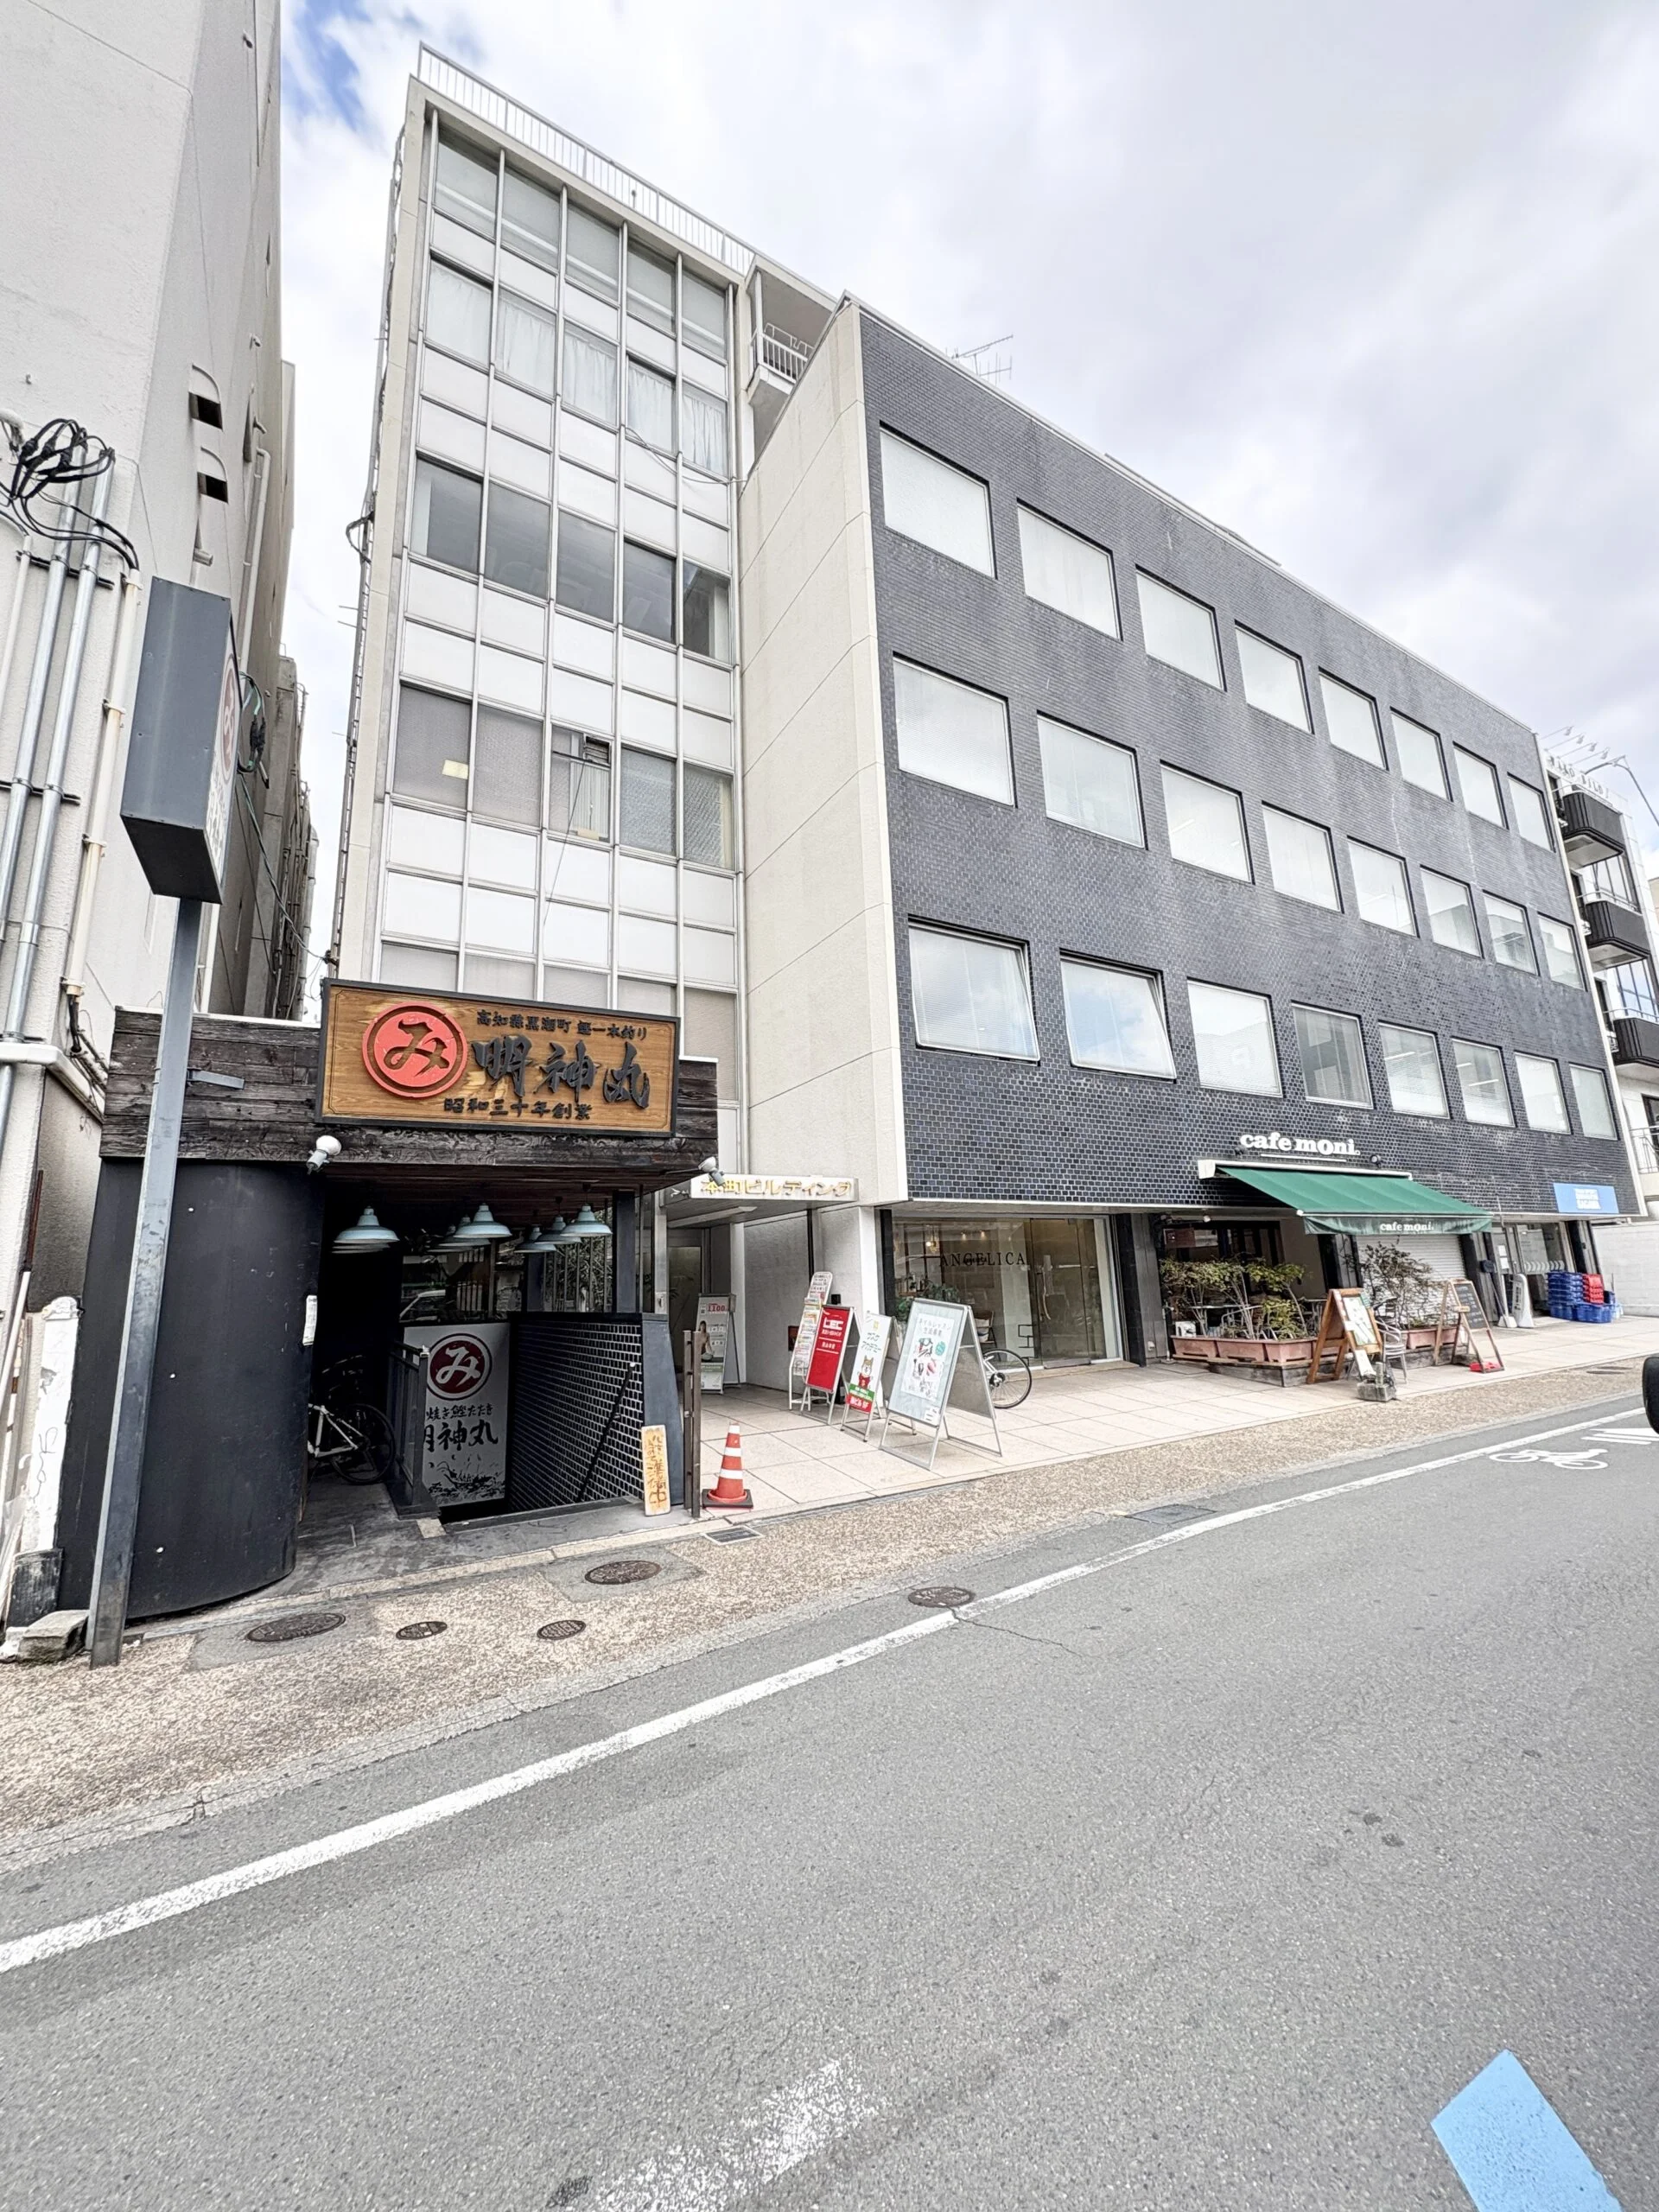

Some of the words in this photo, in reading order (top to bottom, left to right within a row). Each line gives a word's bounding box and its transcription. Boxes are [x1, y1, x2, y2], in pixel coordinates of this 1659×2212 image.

[384, 1020, 450, 1077] み
[471, 1033, 651, 1110] 明神丸
[443, 1097, 593, 1121] 昭和三十年創業
[1239, 1132, 1293, 1152] cafe
[701, 1179, 852, 1198] 本町ビルディング
[1379, 1221, 1403, 1231] cafe
[940, 1251, 1026, 1267] ANGELICA
[435, 1346, 481, 1388] み
